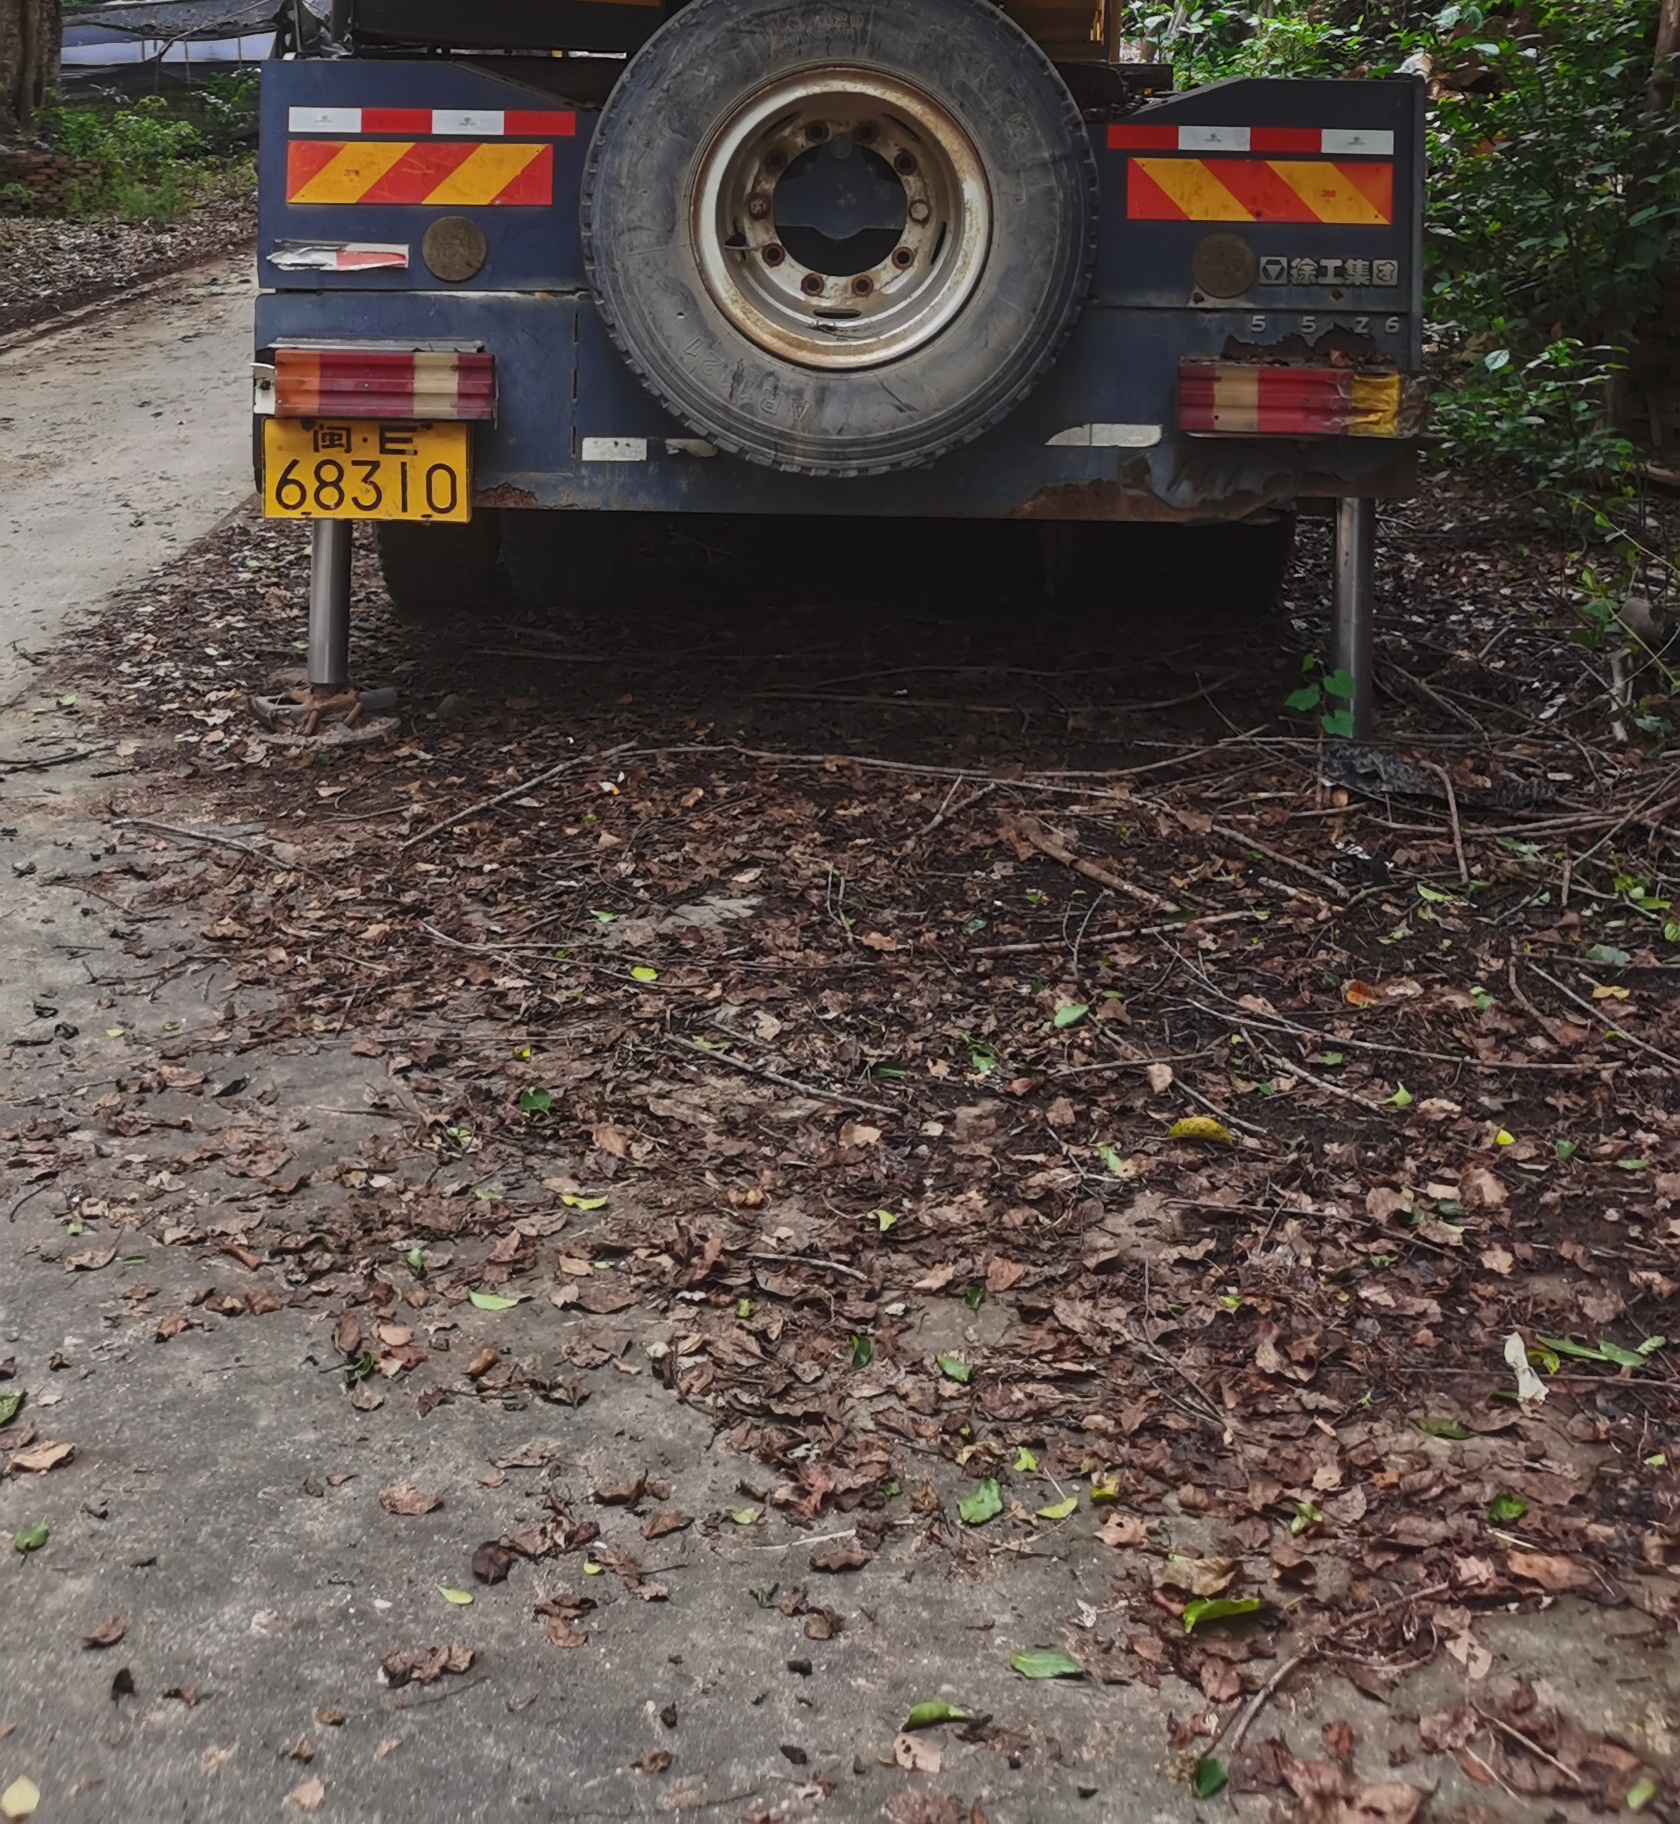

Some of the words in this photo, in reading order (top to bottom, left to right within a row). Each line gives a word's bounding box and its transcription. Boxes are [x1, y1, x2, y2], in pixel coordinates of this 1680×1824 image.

[1290, 257, 1399, 286] 徐工集团
[275, 458, 458, 515] 68310
